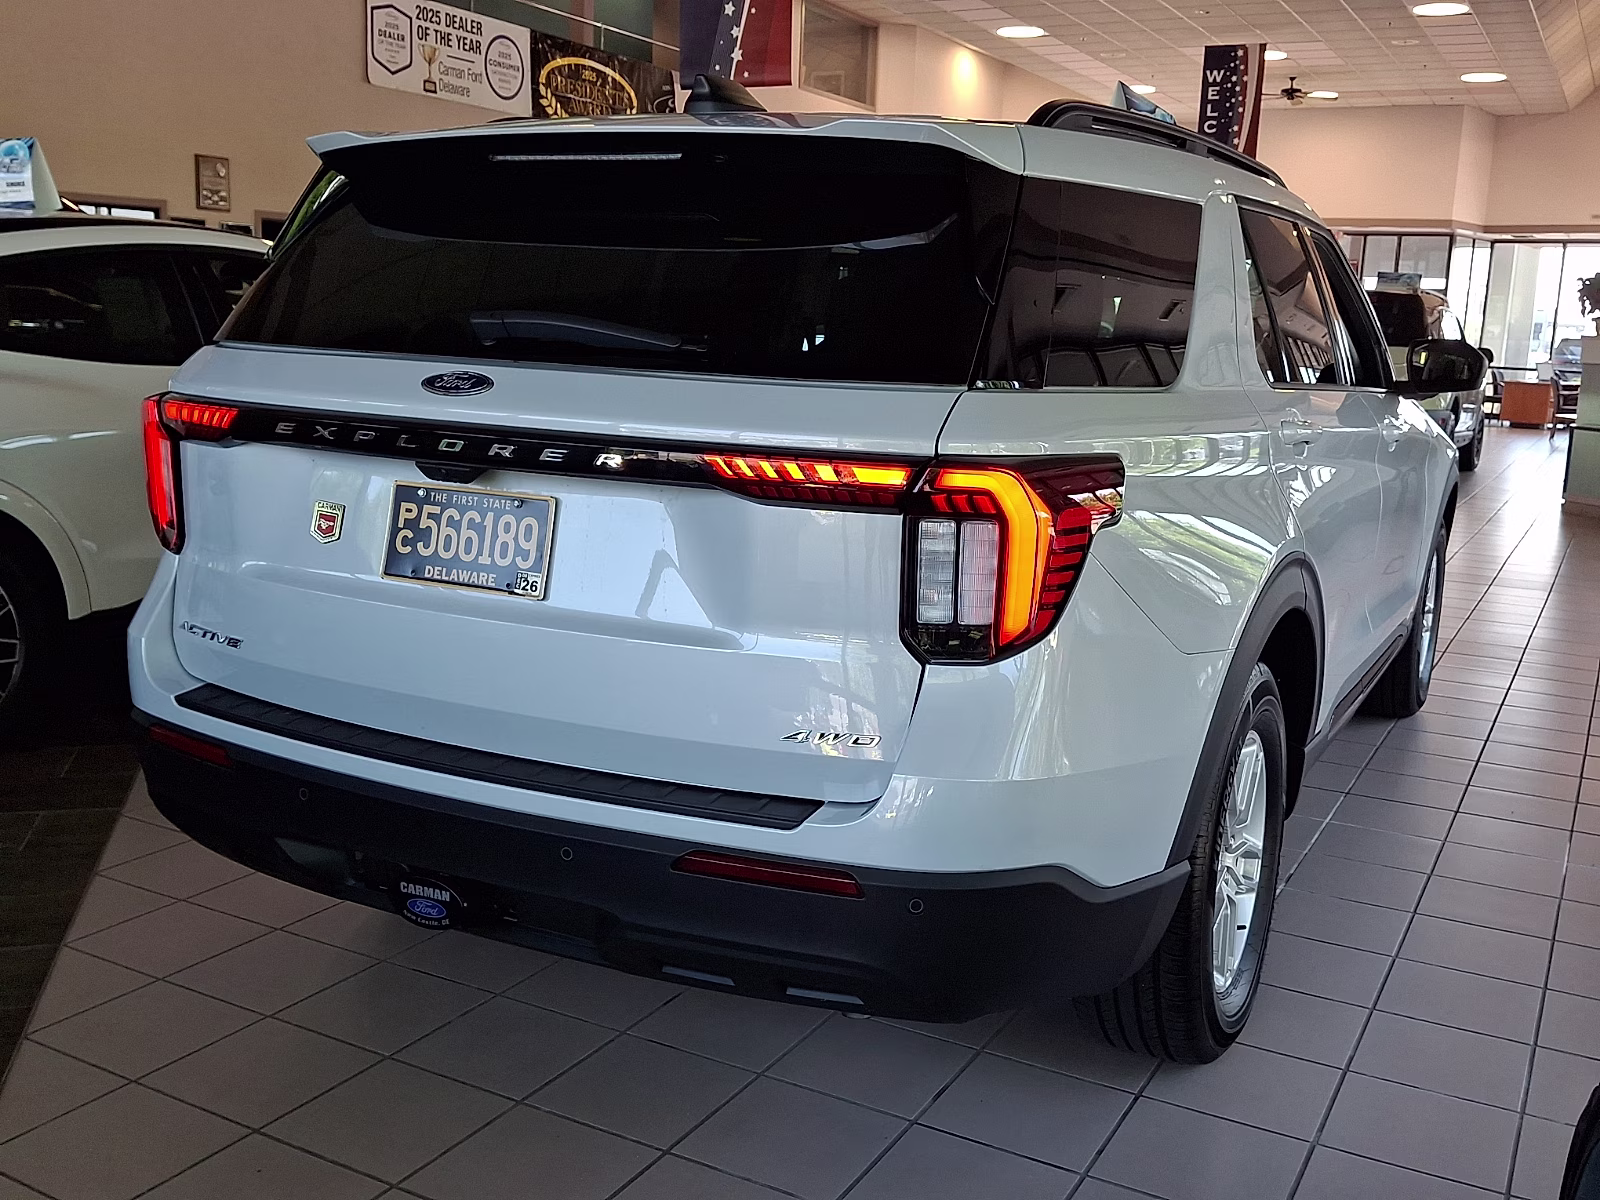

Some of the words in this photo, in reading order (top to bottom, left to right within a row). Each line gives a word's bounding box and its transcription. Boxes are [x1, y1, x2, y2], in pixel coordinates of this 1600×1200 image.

[415, 4, 441, 26] 2025
[445, 11, 483, 37] DEALER
[377, 28, 406, 42] DEALER
[416, 24, 430, 42] OF
[433, 28, 453, 49] THE
[455, 33, 482, 55] YEAR
[438, 60, 466, 80] Carman
[466, 67, 483, 85] Ford
[581, 69, 597, 82] 2025
[438, 77, 471, 98] Delaware
[274, 421, 624, 471] EXPLORER
[430, 491, 448, 503] THE
[452, 494, 479, 507] FIRST
[482, 498, 511, 511] STATE
[416, 503, 540, 570] 566189
[424, 564, 497, 587] DELAWARE
[520, 579, 540, 594] 26
[179, 620, 244, 650] ACTIVE
[779, 728, 883, 749] 4WD
[400, 881, 450, 902] CARMAN
[414, 900, 440, 916] Ford
